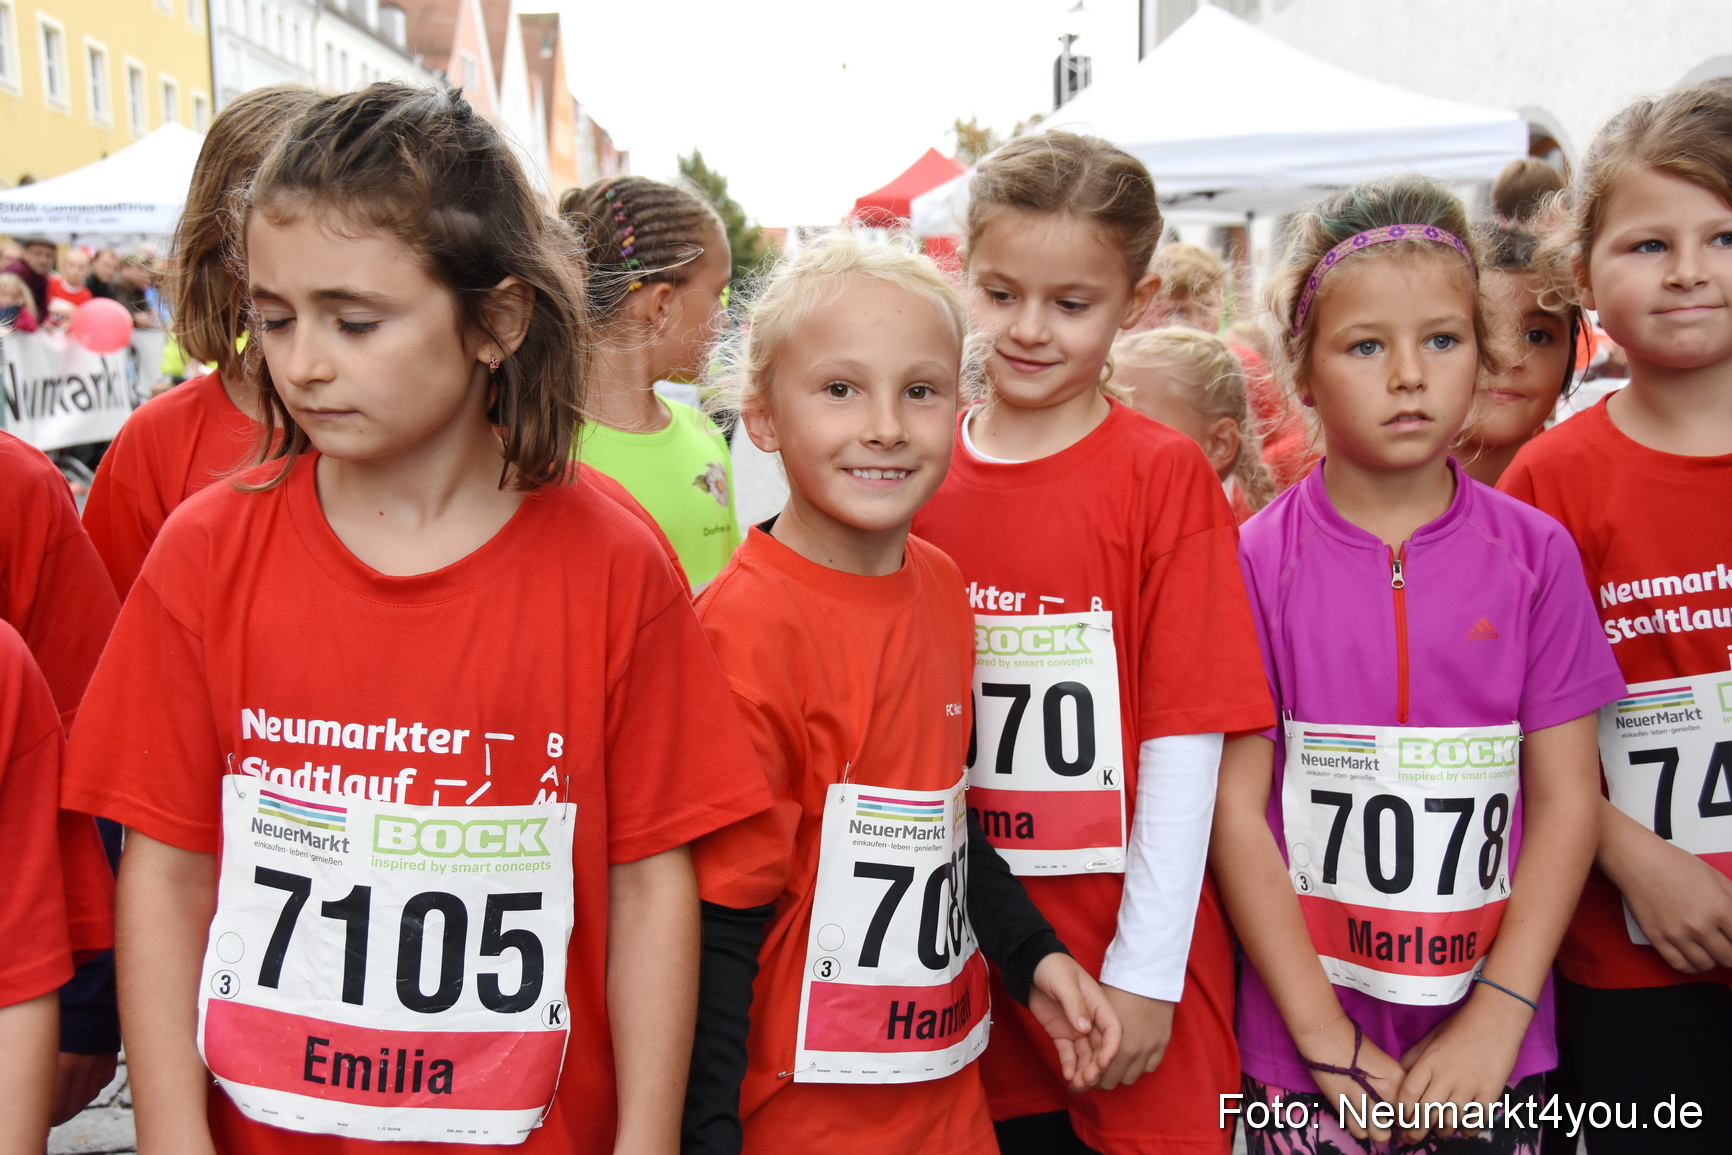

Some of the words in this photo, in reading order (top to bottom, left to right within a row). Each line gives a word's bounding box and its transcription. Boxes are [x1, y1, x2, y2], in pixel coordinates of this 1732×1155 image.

[965, 582, 1026, 612] kter
[1604, 605, 1732, 644] Stadtlau
[999, 658, 1010, 669] by
[1014, 658, 1044, 667] smart
[1048, 657, 1094, 668] concepts
[241, 707, 470, 754] Neumarkter
[1615, 707, 1703, 730] NeuerMarkt
[1301, 753, 1380, 771] NeuerMarkt
[1398, 736, 1518, 769] BOCK
[241, 756, 417, 804] Stadtlauf
[1103, 769, 1114, 786] K
[1398, 770, 1443, 782] inspired
[1447, 771, 1458, 782] by
[1461, 771, 1487, 780] smart
[1489, 769, 1516, 779] concepts
[251, 817, 350, 854] NeuerMarkt
[373, 814, 551, 858] BOCK
[849, 819, 945, 841] NeuerMarkt
[1311, 789, 1509, 896] 7078
[254, 840, 286, 853] einkaufen
[289, 847, 309, 859] leben
[311, 854, 343, 867] genießen
[852, 838, 887, 849] einkaufen
[891, 842, 911, 851] leben
[914, 844, 943, 853] genießen
[371, 855, 426, 871] inspired
[430, 860, 447, 874] by
[451, 860, 491, 873] smart
[495, 860, 551, 874] concepts
[1301, 875, 1309, 892] 3
[254, 865, 545, 1013] 7105
[1348, 916, 1478, 966] Marlene
[820, 960, 832, 978] 3
[219, 974, 232, 995] 3
[548, 1003, 562, 1025] K
[303, 1035, 455, 1095] Emilia
